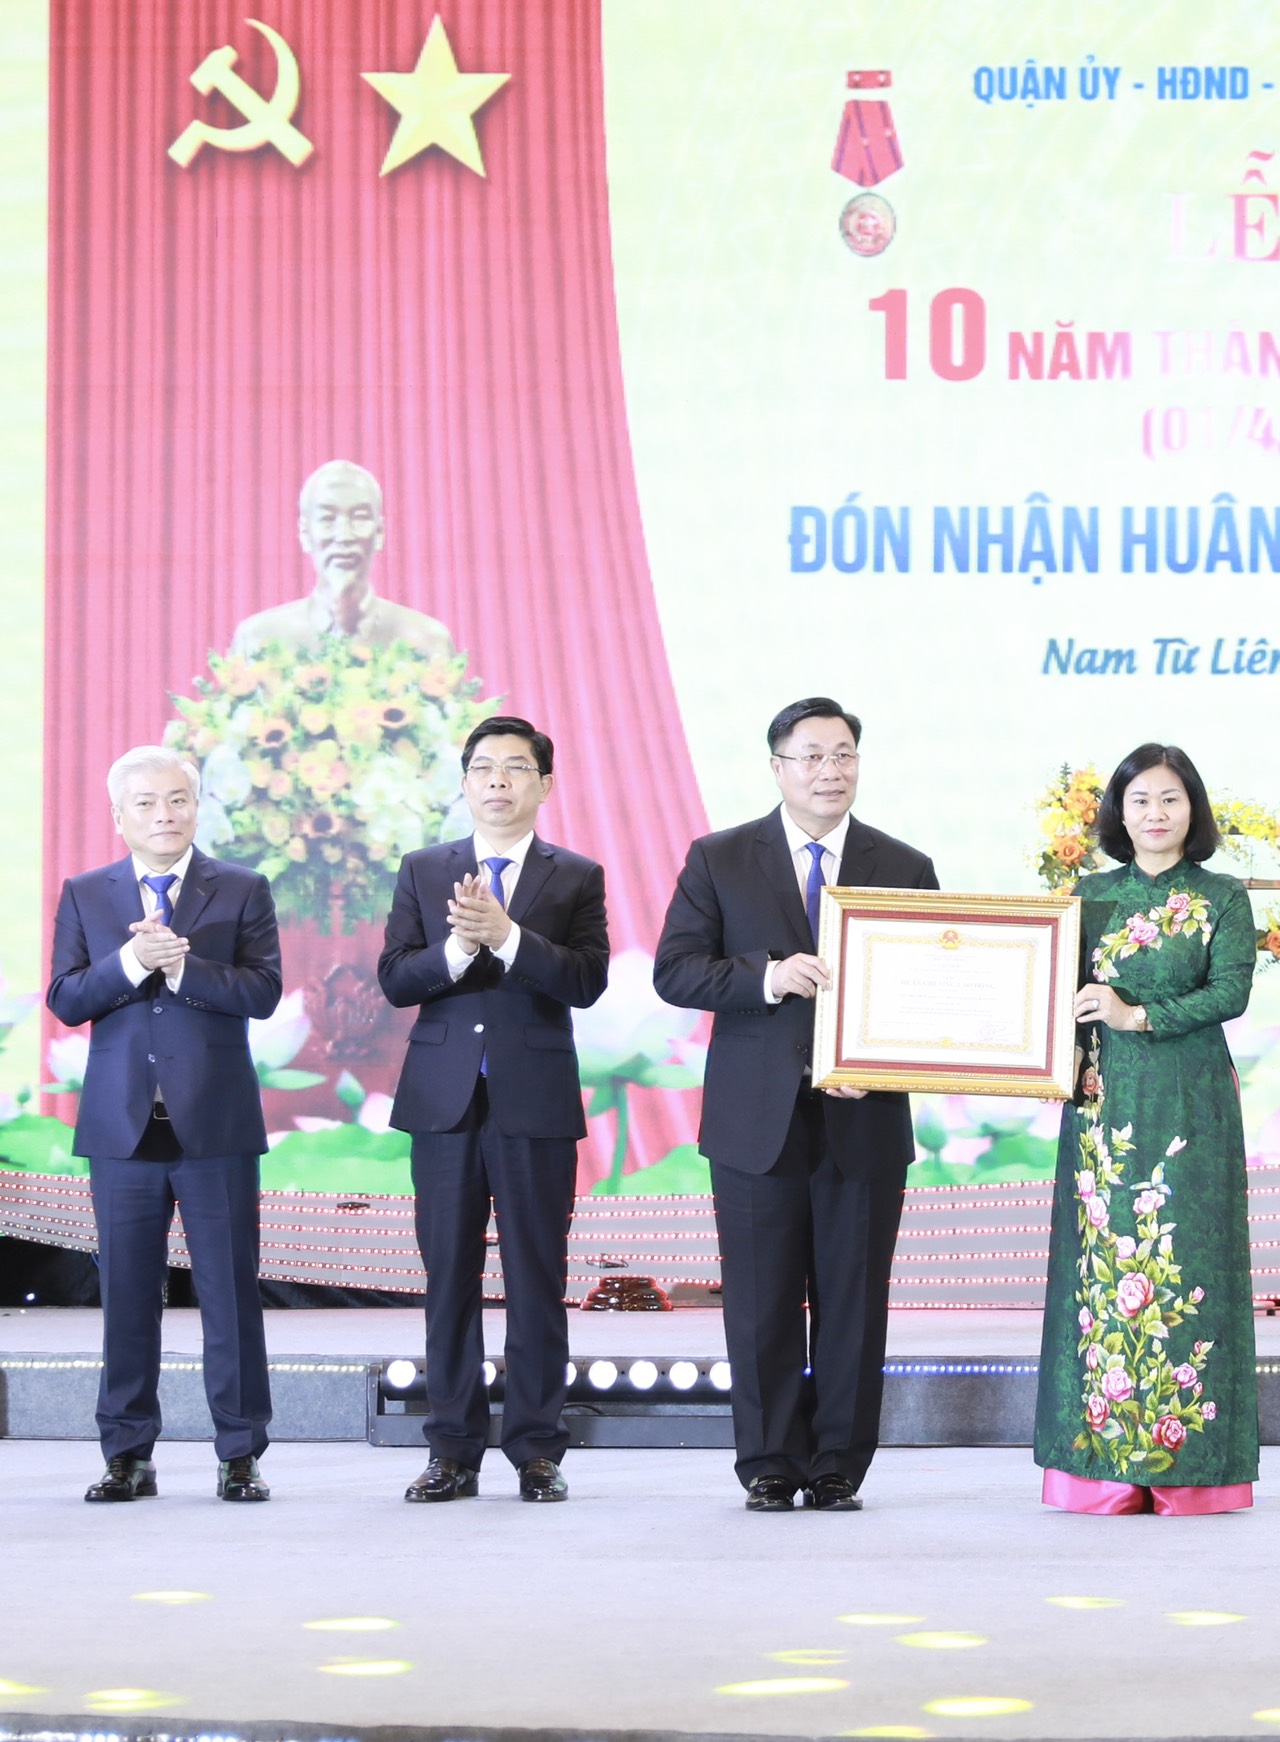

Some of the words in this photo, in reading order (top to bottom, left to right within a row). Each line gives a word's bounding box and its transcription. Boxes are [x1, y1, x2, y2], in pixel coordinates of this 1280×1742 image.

[973, 58, 1067, 109] QUẬN
[1079, 53, 1122, 102] ỦY
[1133, 82, 1146, 91] -
[1157, 65, 1250, 101] HĐND
[1262, 81, 1275, 91] -
[868, 286, 988, 383] 10
[1007, 320, 1133, 381] NĂM
[787, 491, 911, 575] ĐÓN
[932, 491, 1100, 586] NHẬN
[1041, 637, 1138, 676] Nam
[1152, 637, 1201, 676] Từ
